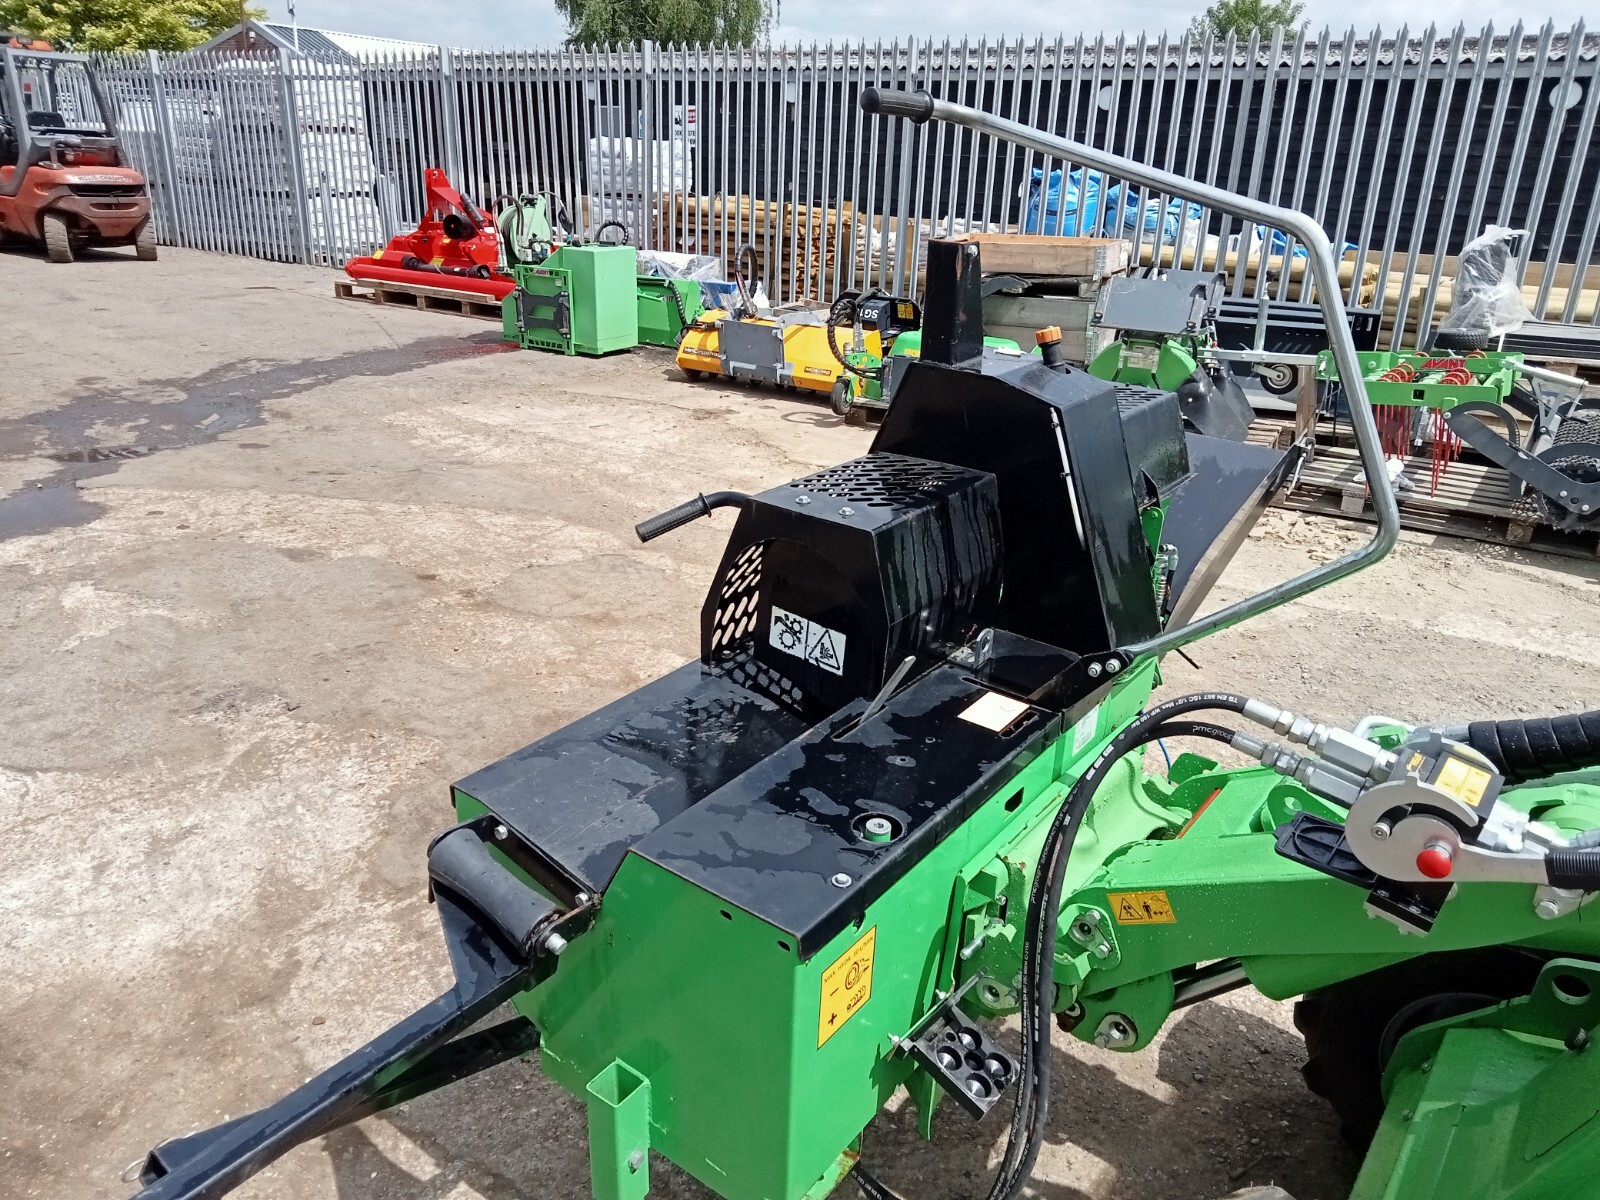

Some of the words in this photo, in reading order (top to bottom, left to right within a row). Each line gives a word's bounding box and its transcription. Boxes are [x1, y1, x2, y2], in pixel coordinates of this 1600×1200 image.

[1418, 358, 1468, 370] AVANT
[1216, 694, 1228, 702] EN
[1150, 708, 1161, 717] WP
